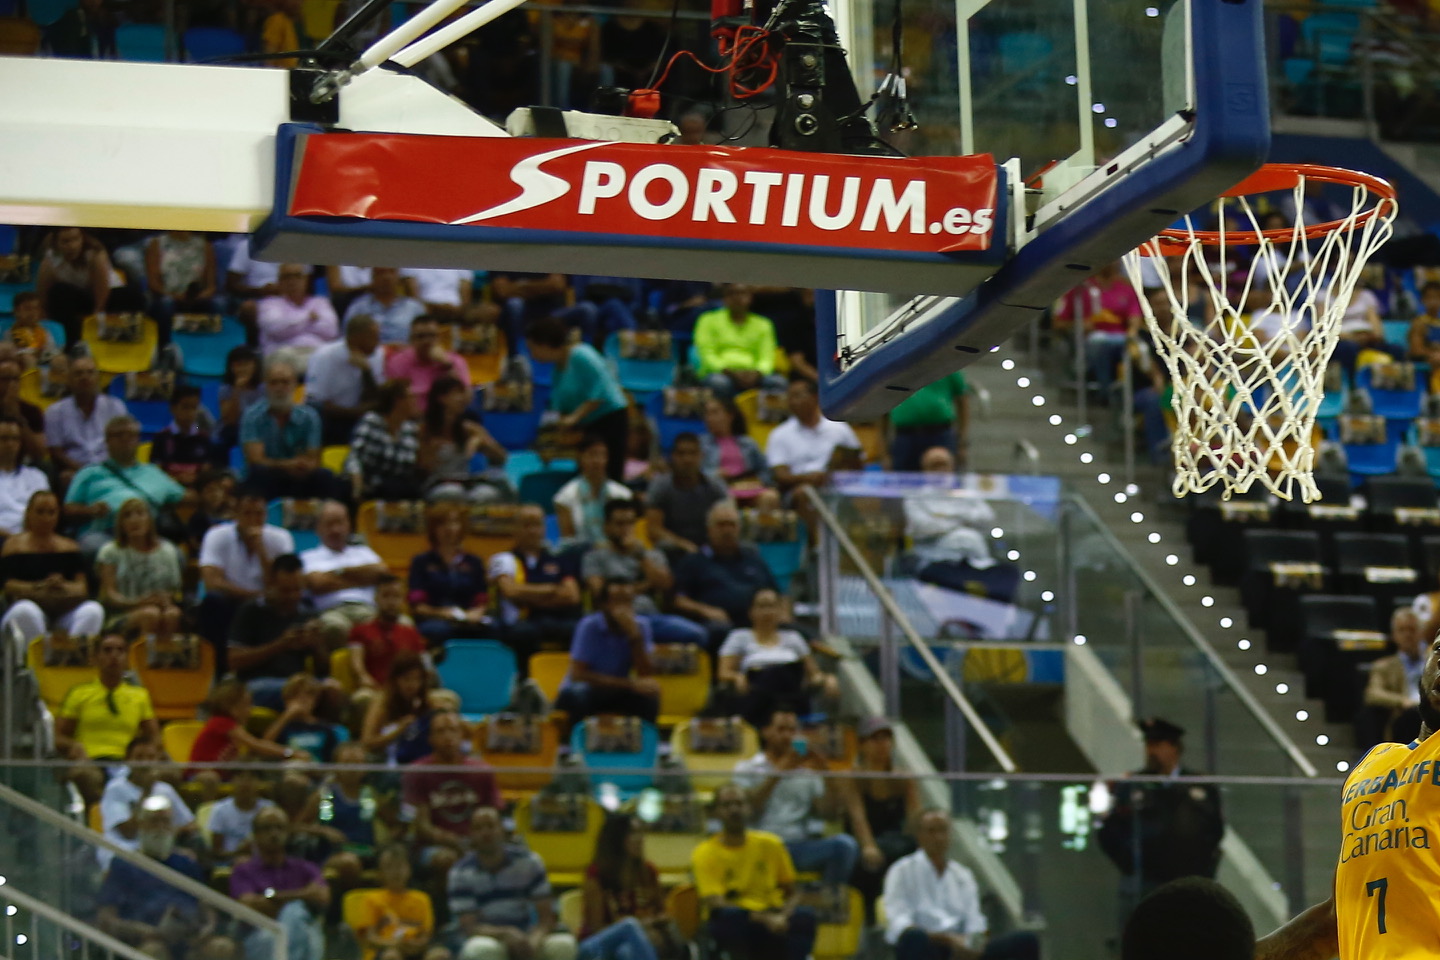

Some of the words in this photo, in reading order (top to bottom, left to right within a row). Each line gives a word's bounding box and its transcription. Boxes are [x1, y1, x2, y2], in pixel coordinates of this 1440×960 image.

[1351, 799, 1407, 831] Gran
[1341, 817, 1431, 864] Canaria
[1366, 877, 1388, 935] 7
